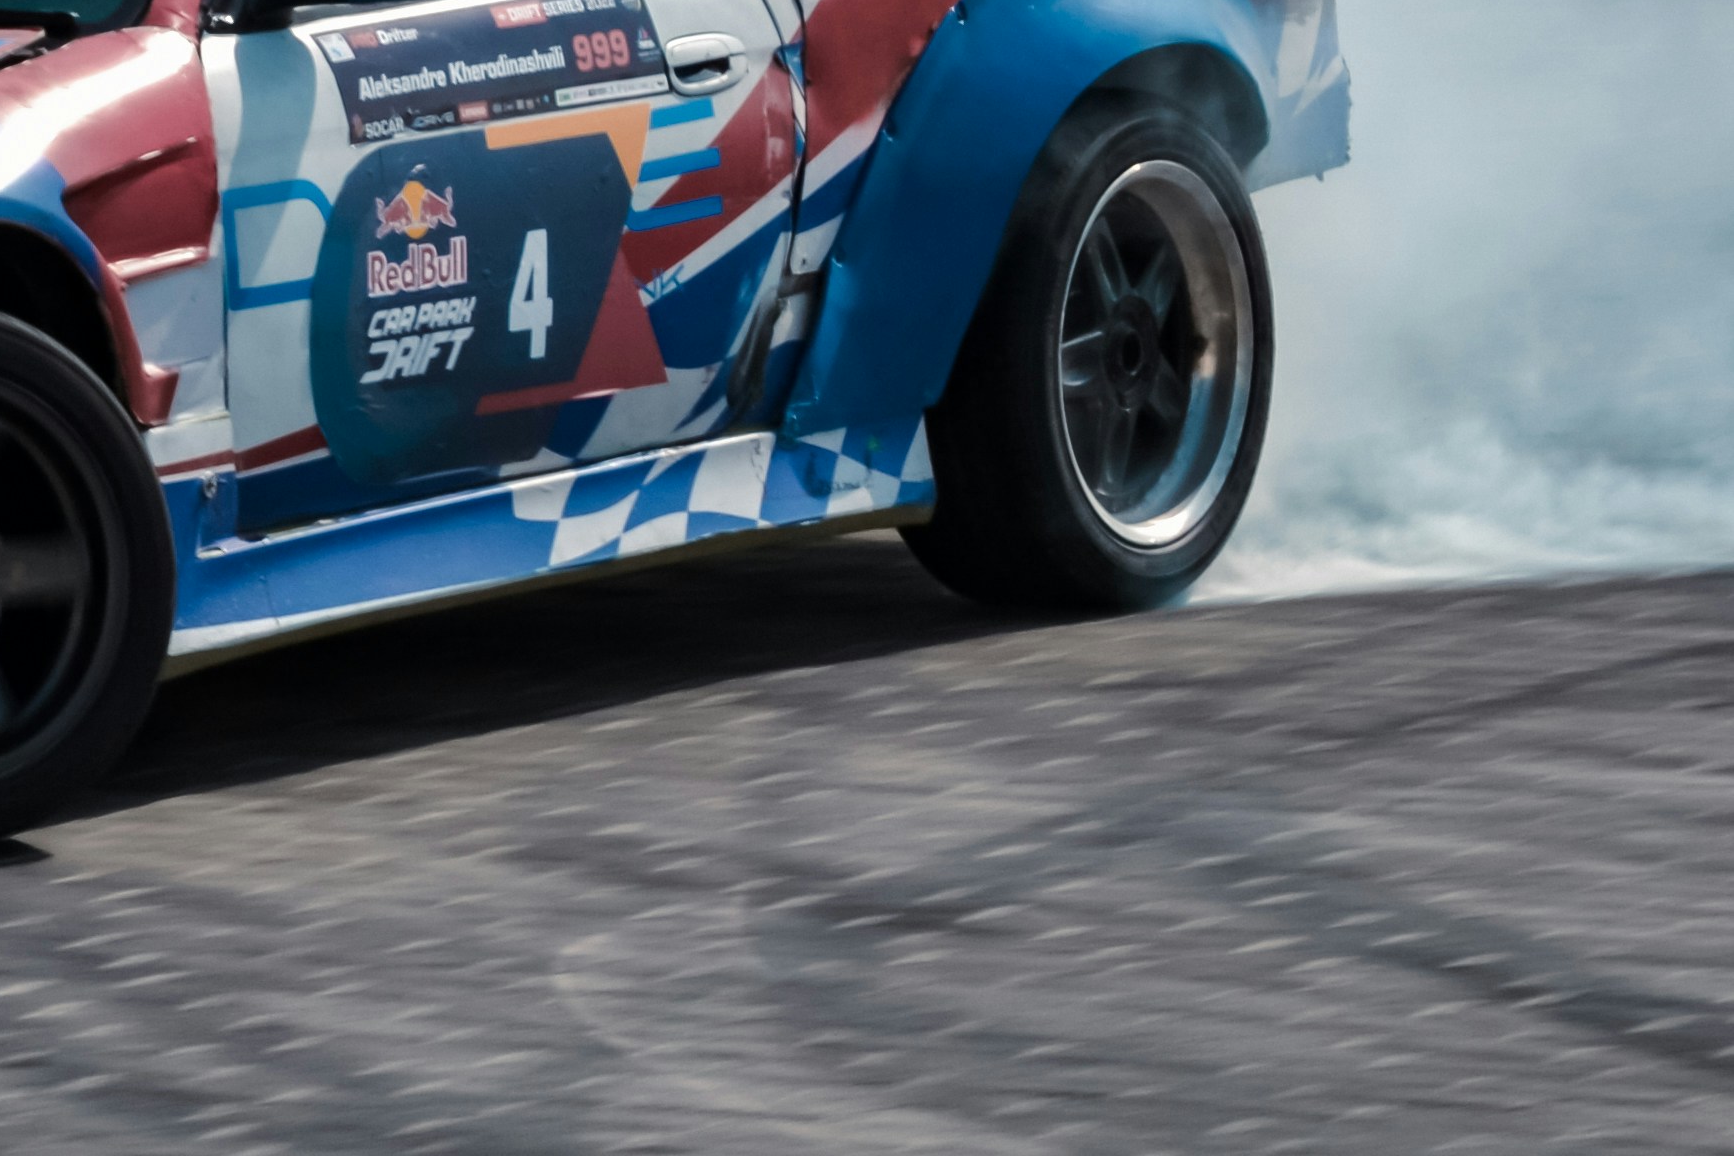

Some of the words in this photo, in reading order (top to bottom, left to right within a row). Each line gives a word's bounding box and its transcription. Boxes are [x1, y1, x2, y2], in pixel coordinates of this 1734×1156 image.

[506, 2, 542, 22] DRIFT
[359, 66, 447, 101] Aleksandre
[448, 44, 566, 86] Kherodinashvili
[572, 28, 631, 72] 999
[365, 115, 405, 139] SOCAR
[368, 243, 418, 297] Red
[418, 235, 468, 291] Bull
[367, 305, 417, 339] CAR
[414, 296, 477, 331] PARK
[508, 228, 553, 360] 4
[359, 326, 475, 385] DRIFT
